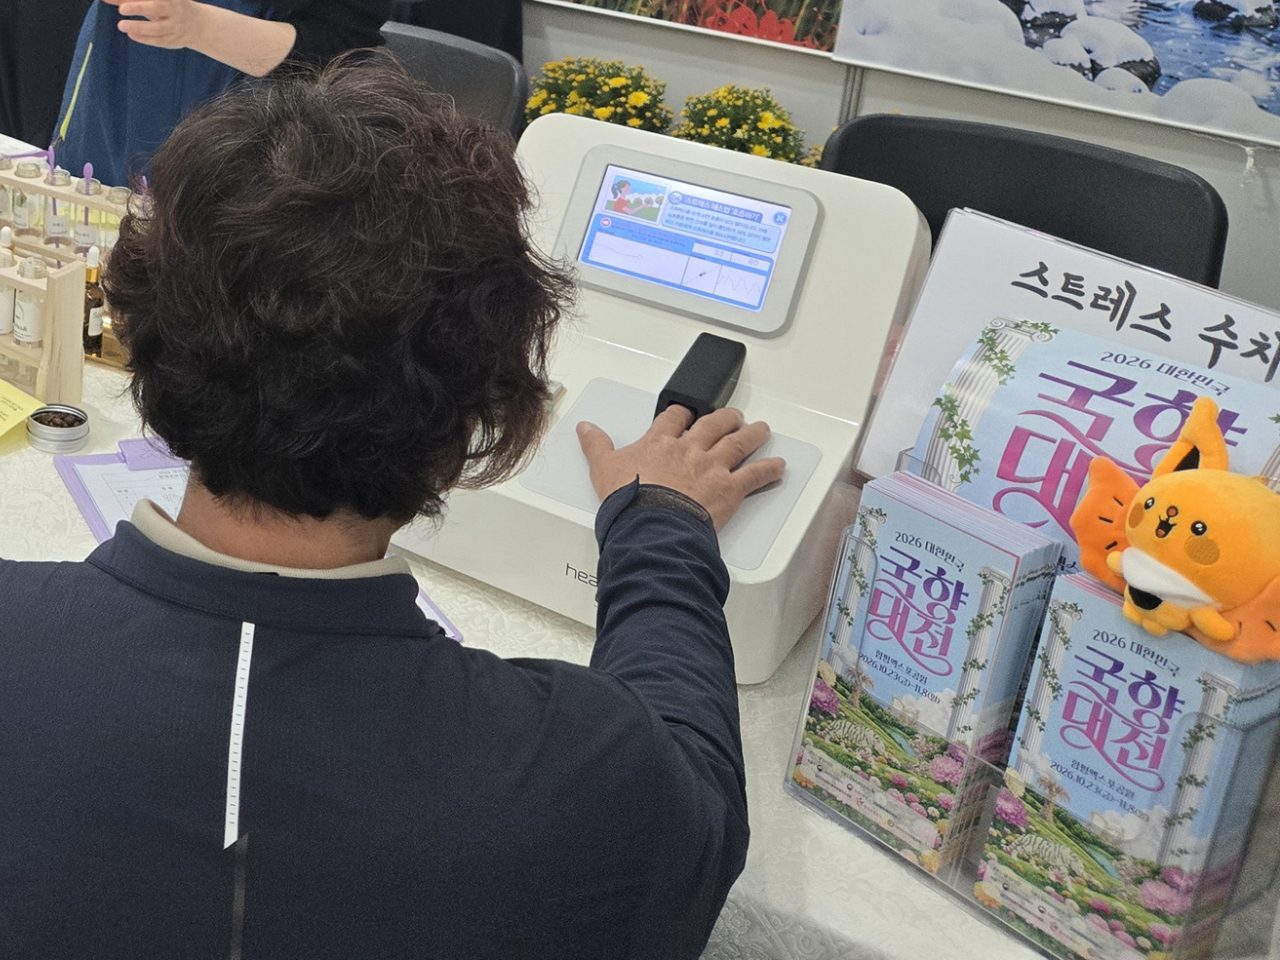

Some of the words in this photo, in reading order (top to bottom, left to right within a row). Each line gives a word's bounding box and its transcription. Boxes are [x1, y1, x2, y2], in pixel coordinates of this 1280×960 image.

[1010, 261, 1172, 343] 스트레스
[1198, 314, 1280, 383] 수치
[1100, 351, 1152, 370] 2026
[1156, 362, 1230, 397] 대한민국
[565, 562, 599, 588] hea
[880, 546, 969, 625] 국향
[895, 531, 922, 548] 2026
[925, 541, 965, 573] 대한민국
[866, 588, 954, 677] 대전
[1093, 630, 1126, 649] 2026
[1129, 641, 1180, 678] 대한민국
[1074, 645, 1186, 735] 국향
[1059, 689, 1167, 793] 대전
